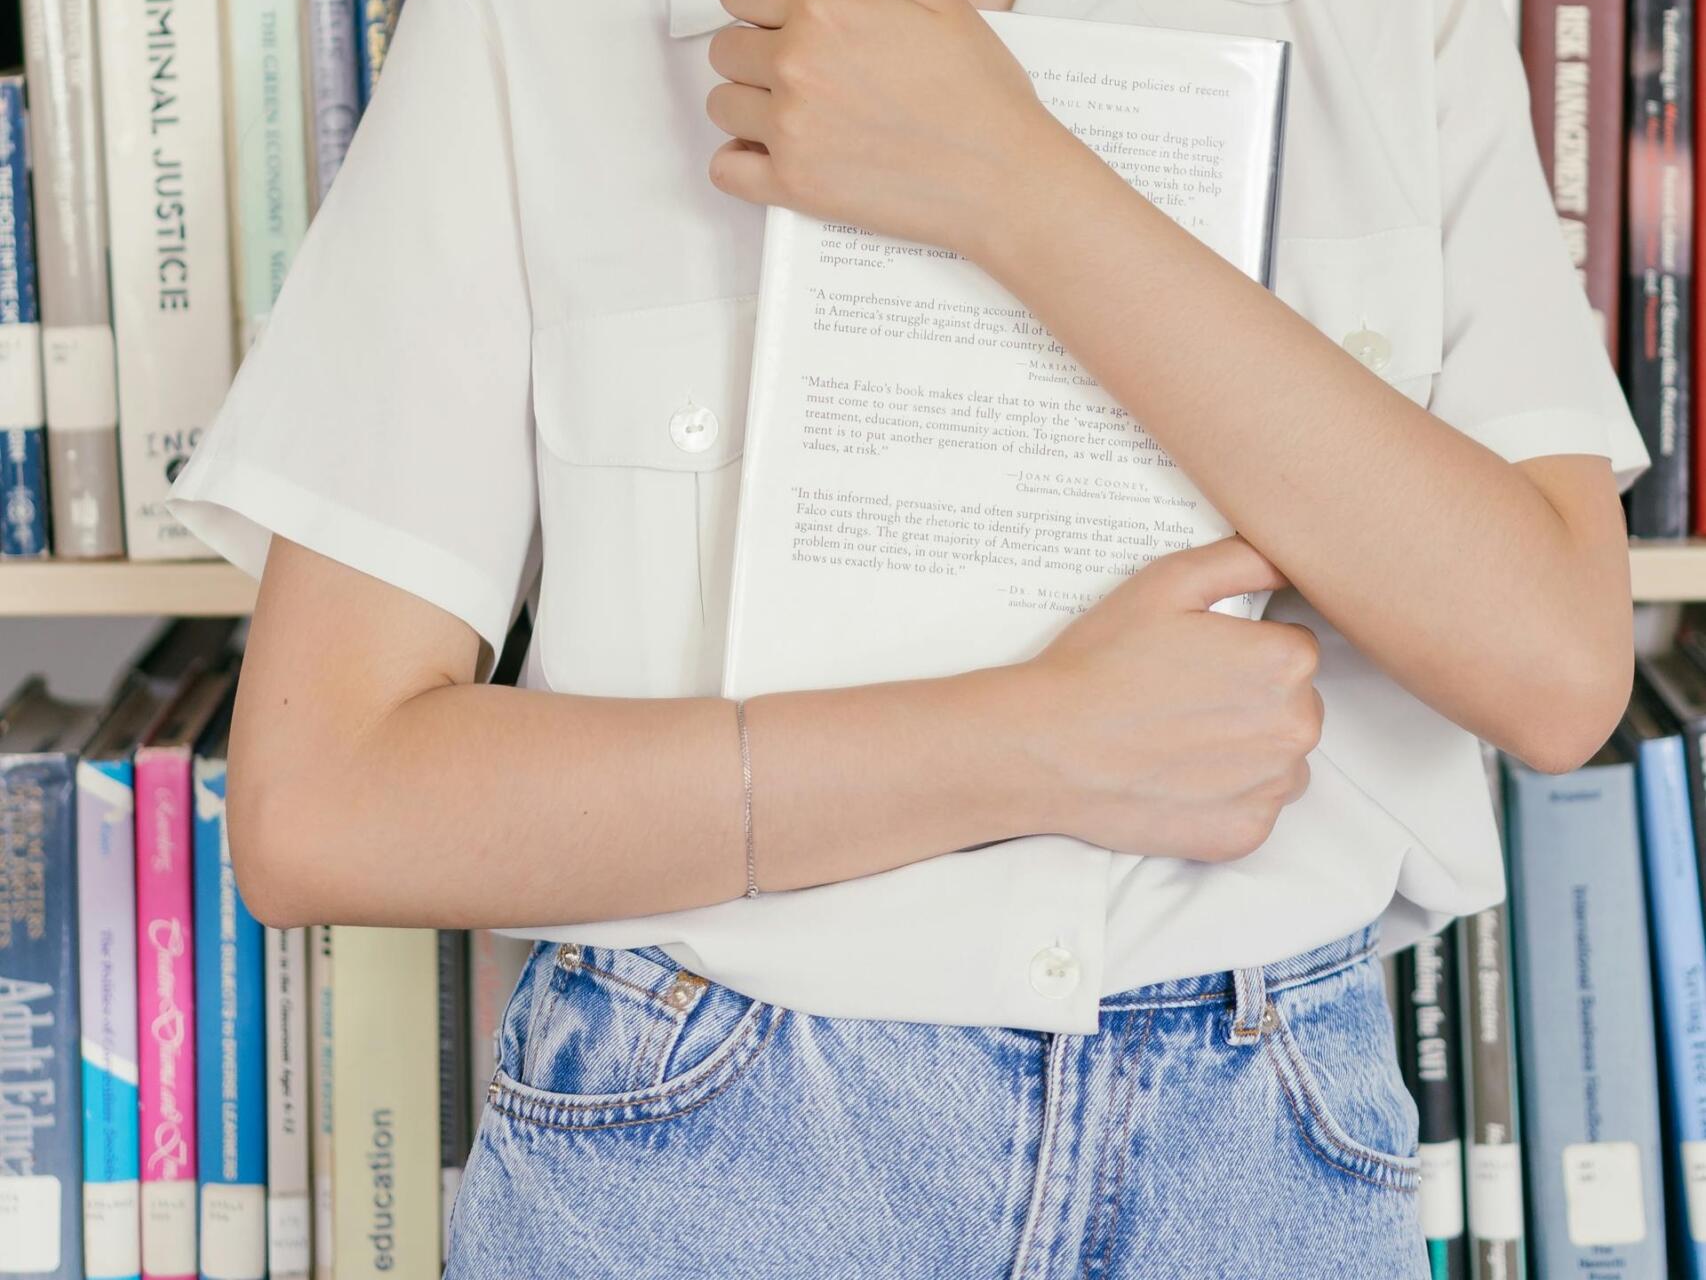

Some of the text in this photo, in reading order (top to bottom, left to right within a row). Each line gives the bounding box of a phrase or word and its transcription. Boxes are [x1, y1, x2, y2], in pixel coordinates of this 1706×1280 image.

[1555, 5, 1591, 59] RISK
[1044, 69, 1061, 81] the
[1066, 71, 1096, 84] failed
[1101, 74, 1127, 90] drug
[1132, 78, 1174, 92] policies
[1179, 82, 1190, 94] of
[1195, 87, 1228, 97] recent
[261, 10, 285, 235] THE GREEN ECONOMY
[1089, 125, 1123, 141] brings
[1126, 130, 1137, 140] to
[1140, 132, 1159, 142] our
[1162, 131, 1188, 148] drug
[1191, 135, 1224, 151] policy
[1555, 61, 1591, 217] MANAGEMENT
[1120, 161, 1160, 175] anyone
[1163, 163, 1186, 176] who
[1189, 165, 1222, 179] thinks
[153, 148, 190, 312] JUSTICE
[821, 239, 841, 249] one
[845, 238, 856, 250] of
[860, 243, 879, 252] our
[884, 246, 922, 257] gravest
[819, 251, 892, 269] importance."
[815, 303, 825, 316] in
[829, 305, 882, 320] America's
[886, 313, 929, 327] struggle
[933, 316, 969, 329] against
[973, 318, 1006, 335] drugs.
[1012, 322, 1028, 334] All
[829, 292, 911, 308] comprehensive
[914, 298, 934, 310] and
[938, 299, 979, 318] riveting
[983, 307, 1024, 319] account
[813, 319, 1044, 353] the future of our children and our country
[801, 375, 1106, 414] "Mathea Falco's book makes clear that to win the war
[802, 438, 838, 453] values,
[843, 445, 853, 454] at
[791, 487, 1193, 535] "In this informed, persuasive, and often surprising investigation, Mathea
[791, 550, 827, 563] shows
[829, 558, 842, 566] us
[844, 556, 884, 570] exactly
[886, 557, 911, 570] how
[914, 562, 926, 572] to
[928, 560, 943, 574] do
[220, 865, 237, 941] ACADEMIC
[101, 929, 114, 956] The
[1573, 885, 1592, 990] International
[220, 943, 238, 1019] SUBJECTS
[0, 977, 55, 1072] Adult
[1577, 995, 1596, 1071] Business
[222, 1038, 239, 1101] DIVERSE
[222, 1102, 239, 1181] LEARNERS
[367, 1108, 394, 1272] education
